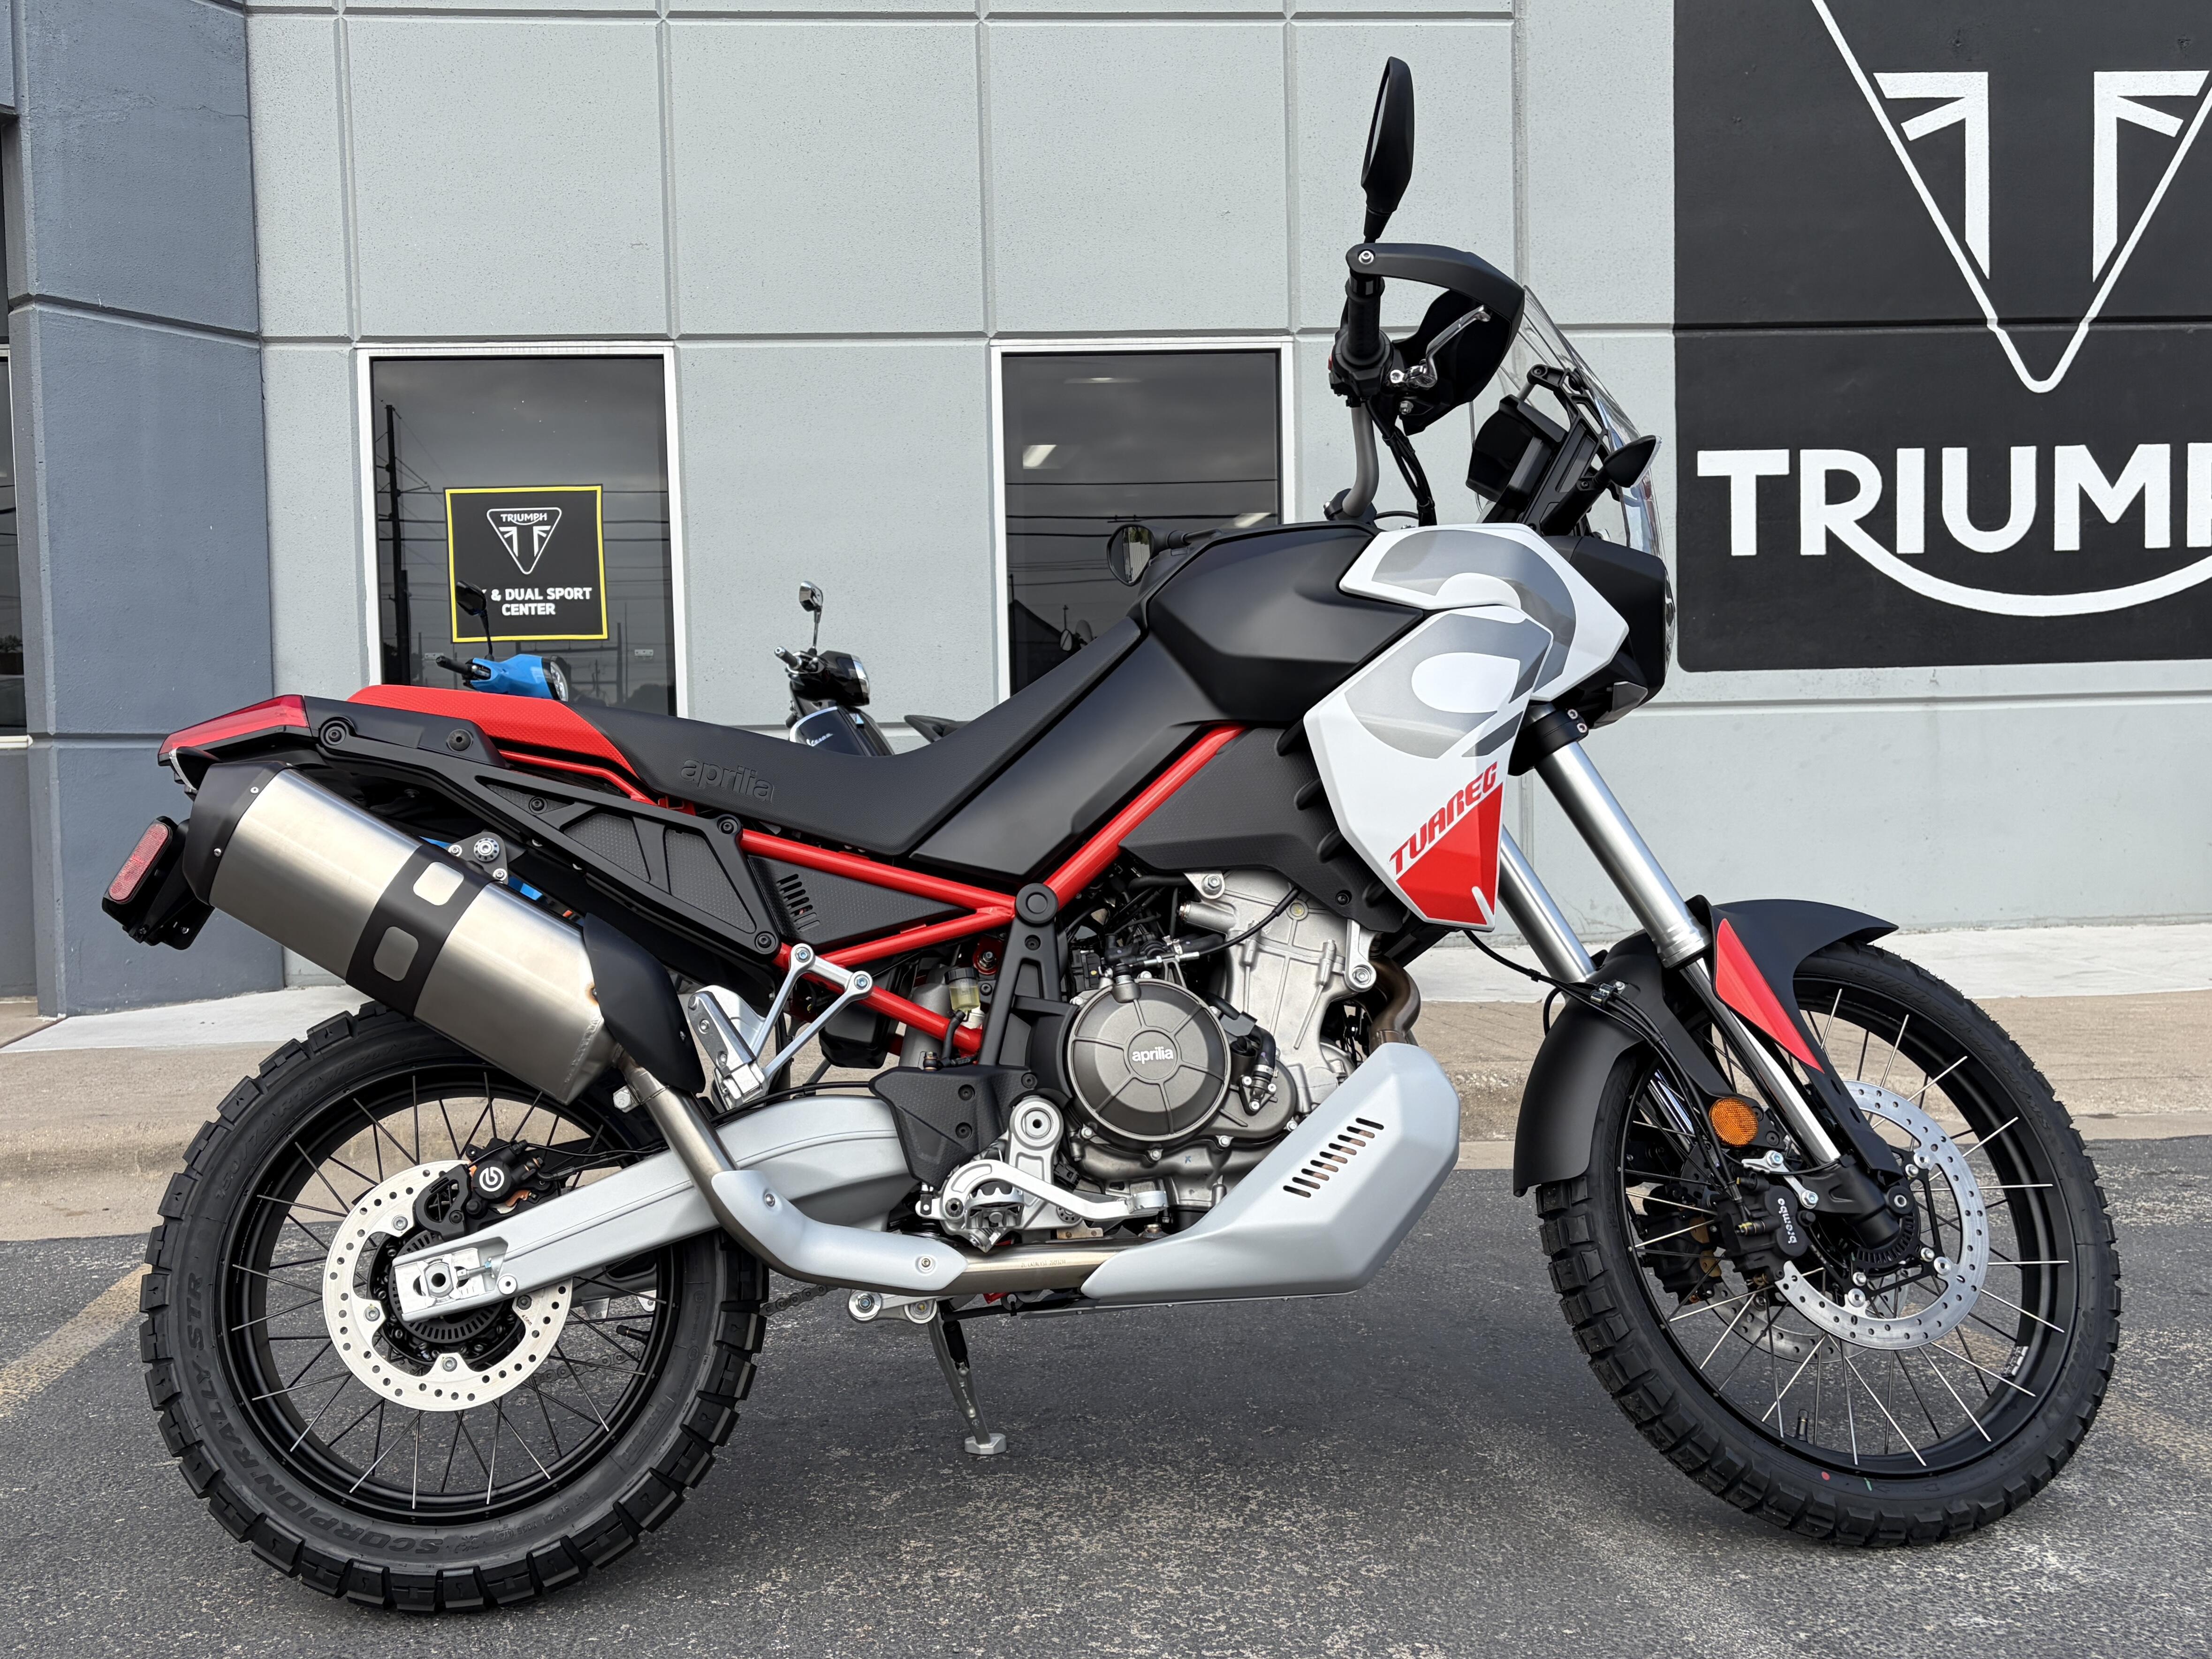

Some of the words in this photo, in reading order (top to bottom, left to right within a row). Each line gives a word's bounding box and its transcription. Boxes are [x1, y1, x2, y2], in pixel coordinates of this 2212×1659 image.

[501, 513, 547, 525] TRIUMPH
[491, 589, 501, 601] &
[505, 588, 543, 601] DUAL
[547, 587, 592, 600] SPORT
[502, 603, 555, 616] CENTER
[680, 760, 775, 802] aprilia
[1389, 761, 1498, 875] TUAREG
[1132, 1045, 1174, 1064] aprilia
[1777, 1197, 1798, 1244] brembo
[186, 1271, 205, 1352] STR
[191, 1359, 259, 1469] RALLY
[254, 1469, 443, 1554] SCORPION
